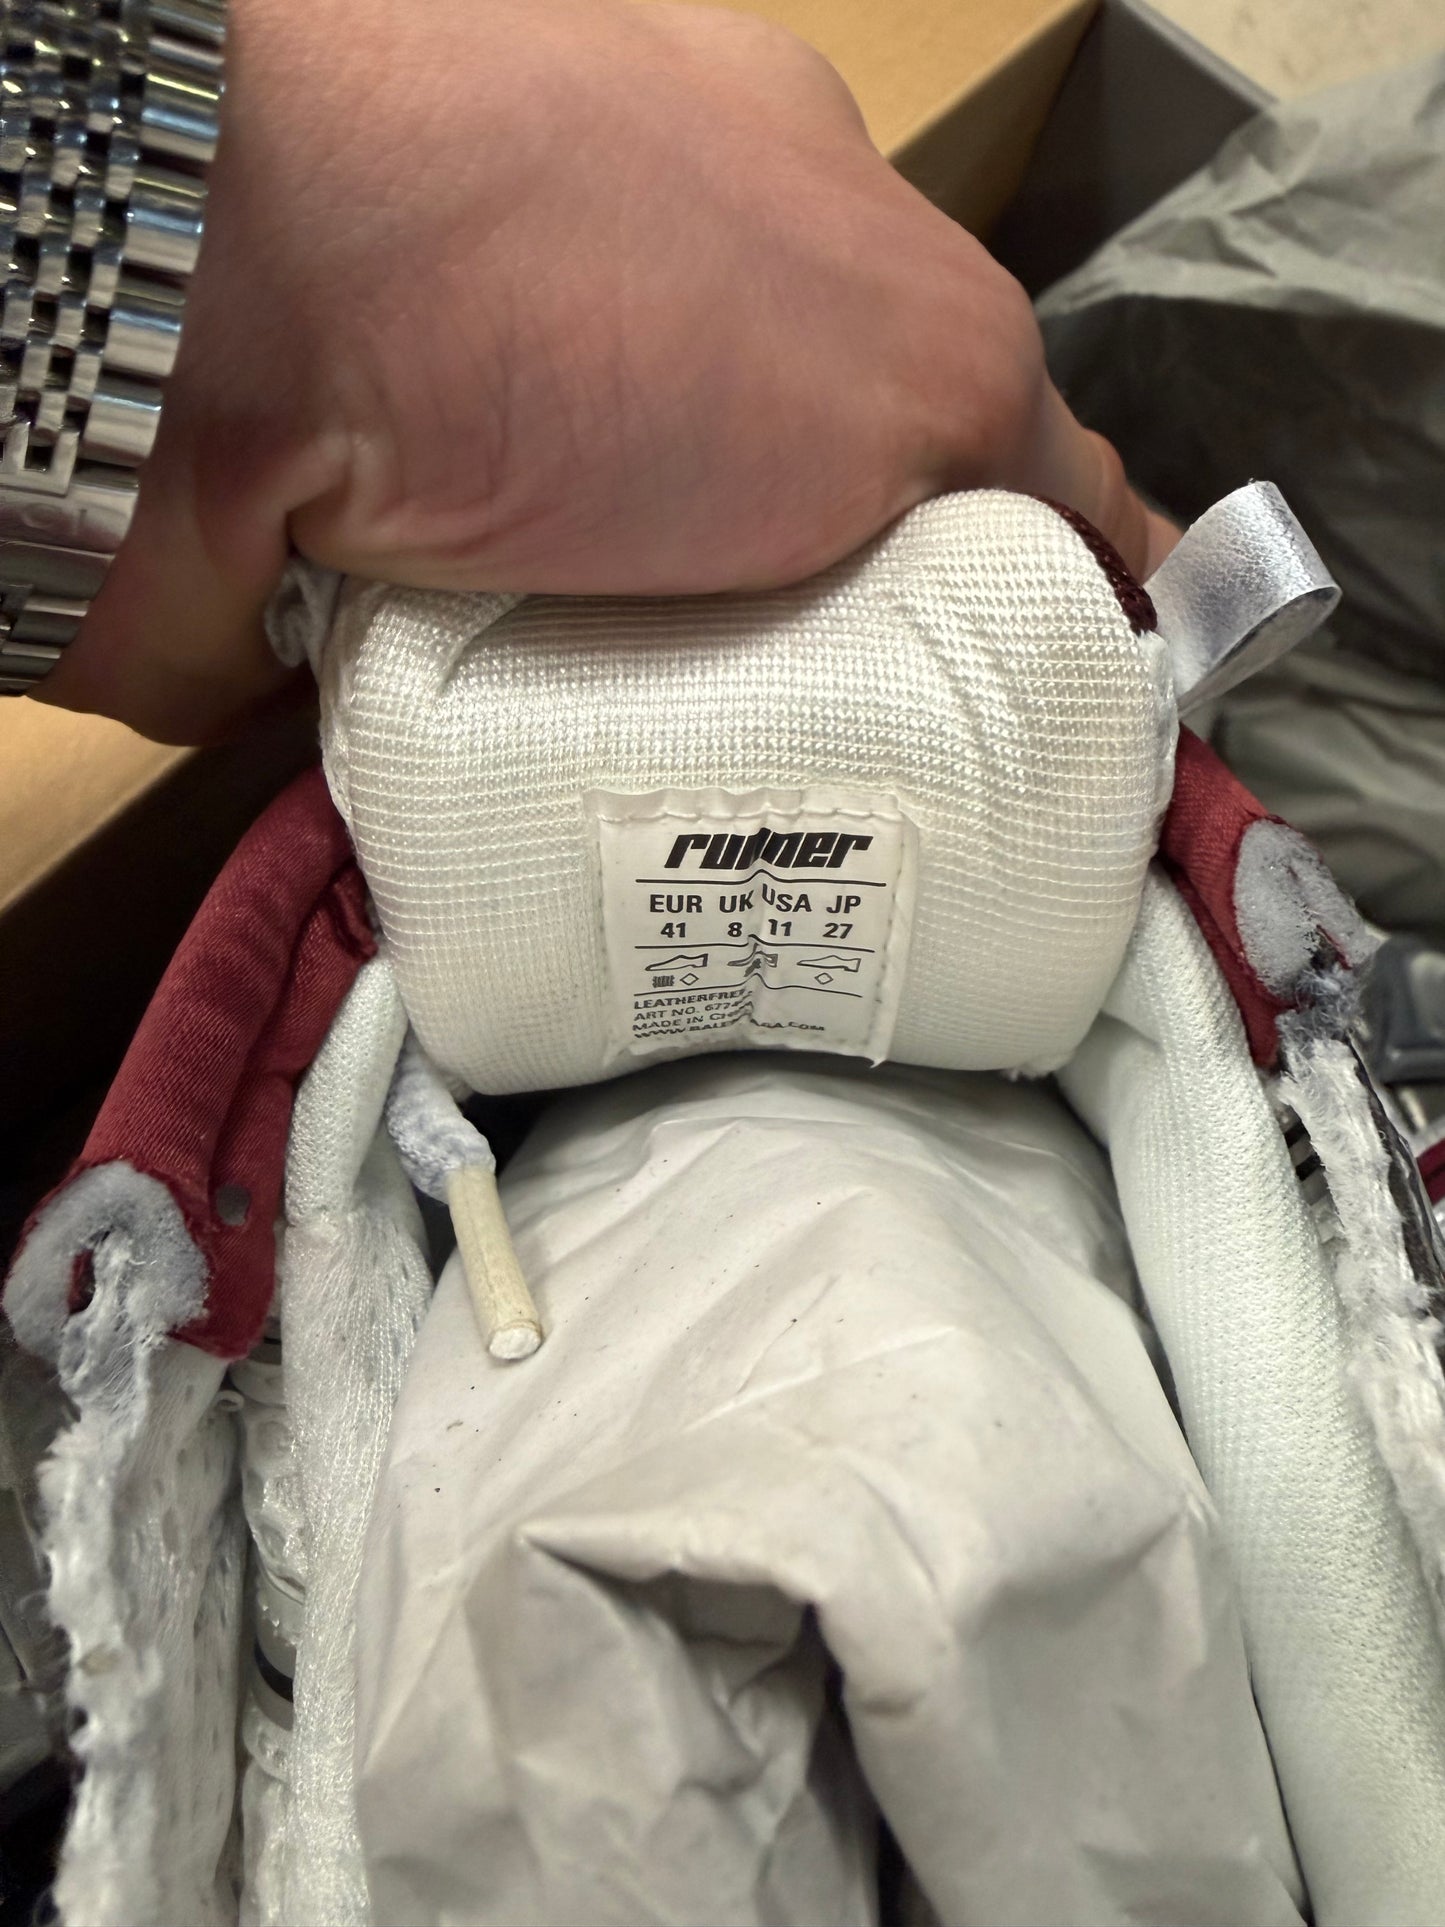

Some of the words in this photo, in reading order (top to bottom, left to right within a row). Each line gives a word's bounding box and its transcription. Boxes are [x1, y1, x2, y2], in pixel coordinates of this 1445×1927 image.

[650, 894, 703, 913] EUR
[719, 890, 755, 913] UK
[761, 883, 812, 913] USA
[826, 895, 861, 914] JP
[660, 922, 687, 938] 41
[727, 922, 743, 938] 8
[768, 918, 792, 937] 11
[822, 922, 854, 939] 27
[632, 1018, 682, 1031] MADE
[687, 1015, 704, 1025] IN
[634, 1010, 667, 1021] ART
